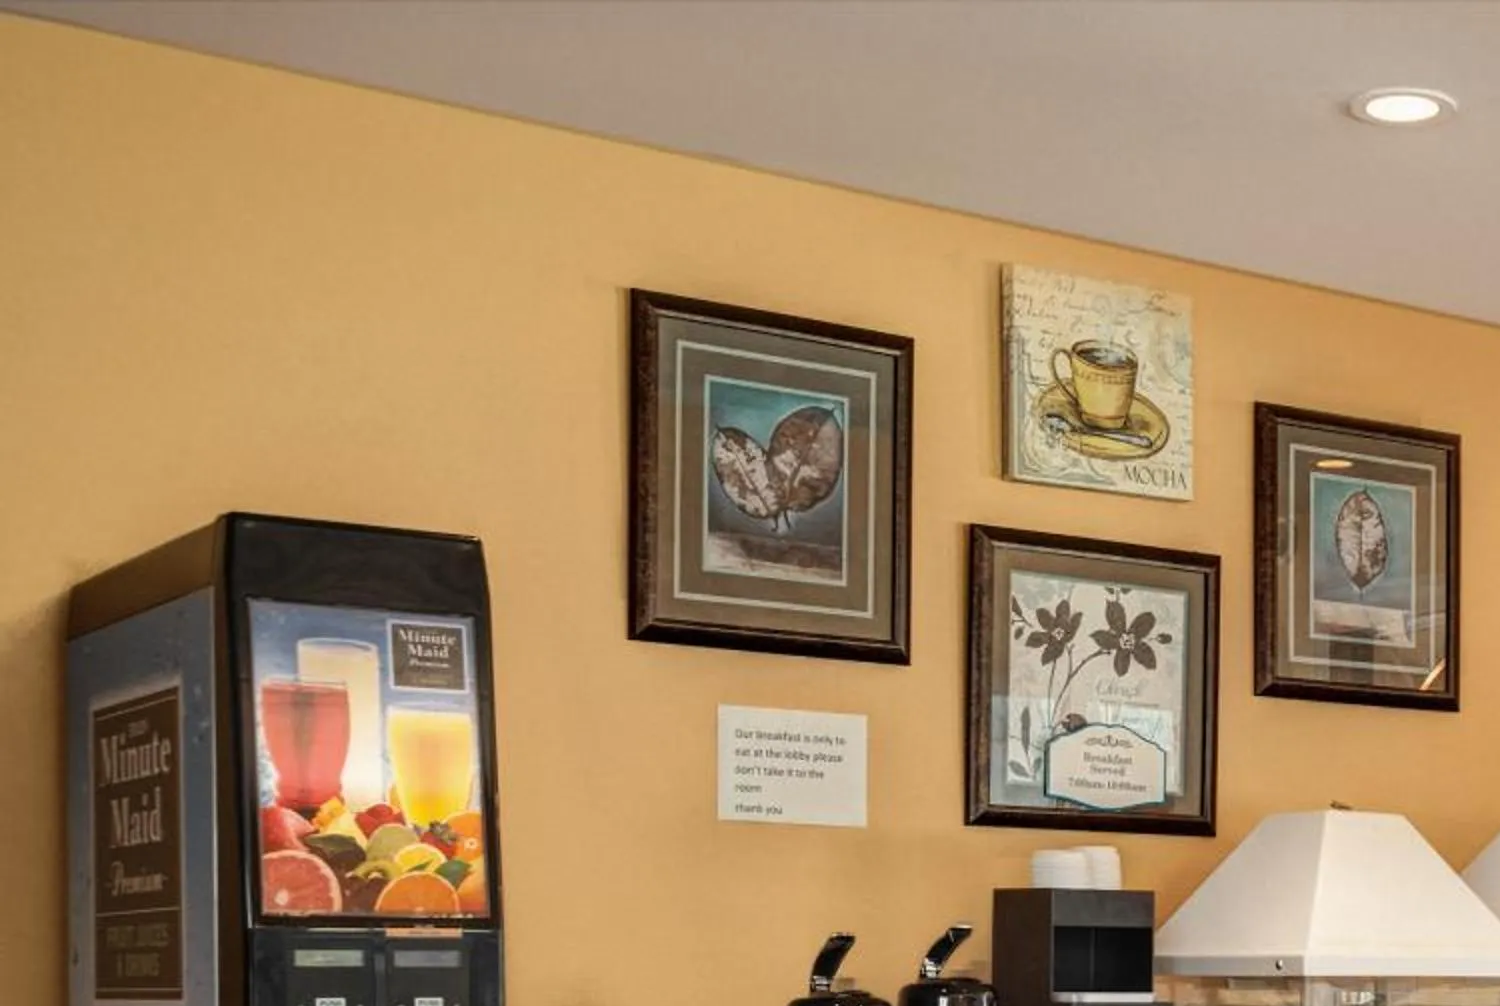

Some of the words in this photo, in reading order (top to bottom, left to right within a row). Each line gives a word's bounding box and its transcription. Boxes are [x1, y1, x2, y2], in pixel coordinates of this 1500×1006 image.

[1123, 464, 1188, 490] MOCHA
[399, 628, 456, 646] Minute
[407, 644, 449, 658] Maid
[99, 730, 172, 787] Minute
[109, 786, 163, 848] Maid
